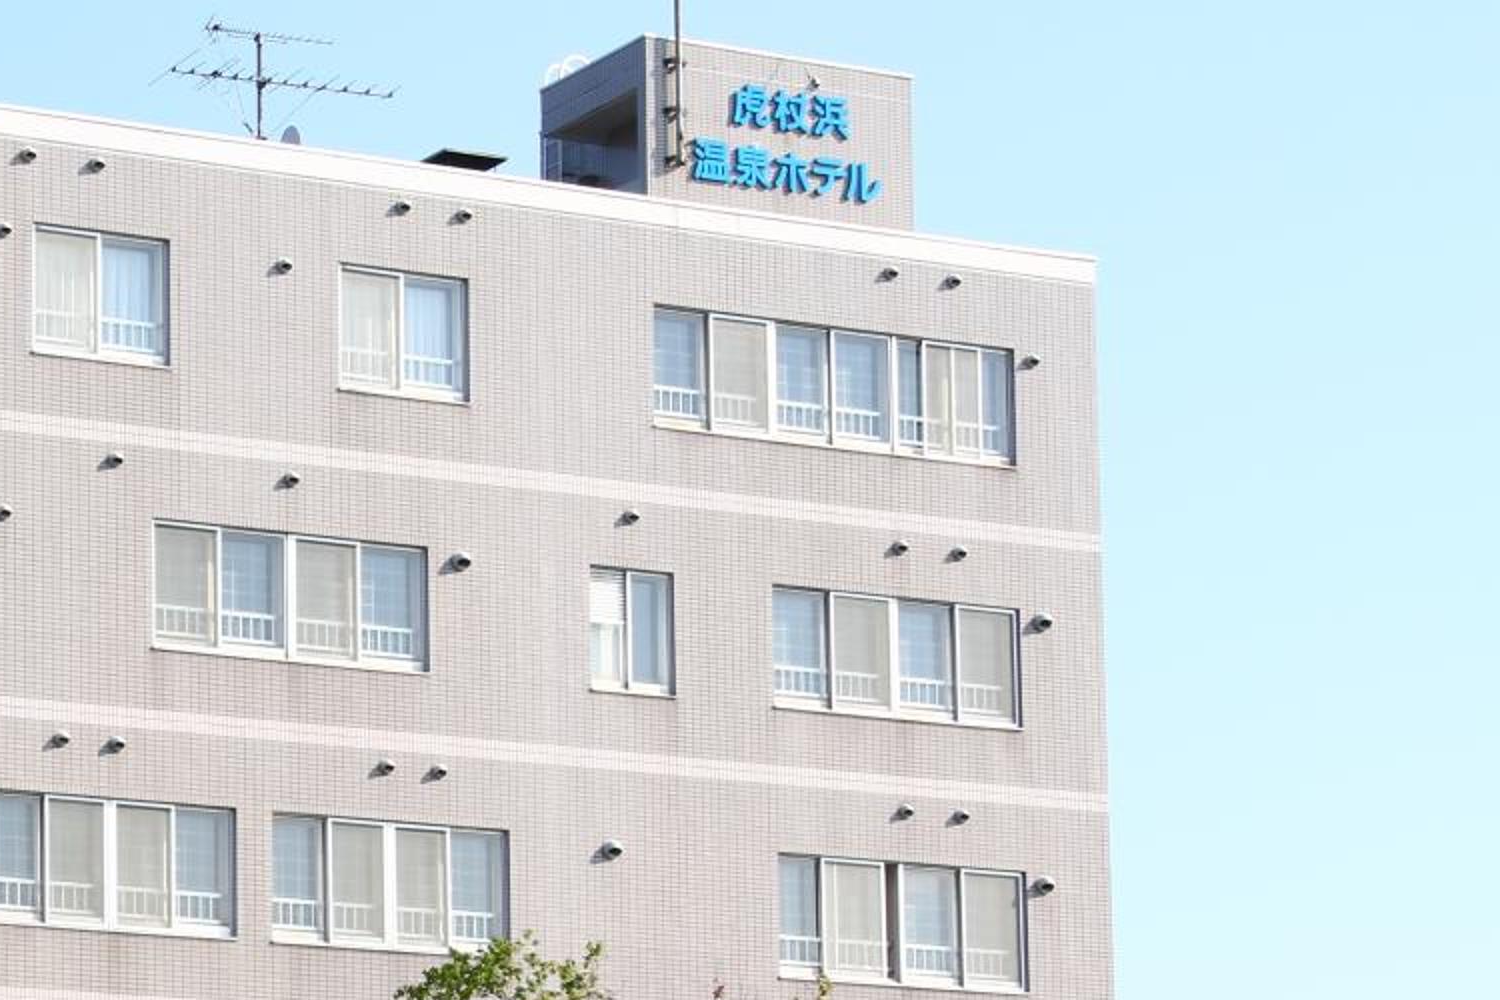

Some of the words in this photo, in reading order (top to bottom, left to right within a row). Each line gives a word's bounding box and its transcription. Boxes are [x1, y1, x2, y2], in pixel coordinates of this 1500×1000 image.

[731, 82, 850, 138] 虎杖浜
[690, 137, 882, 203] 温泉ホテル
